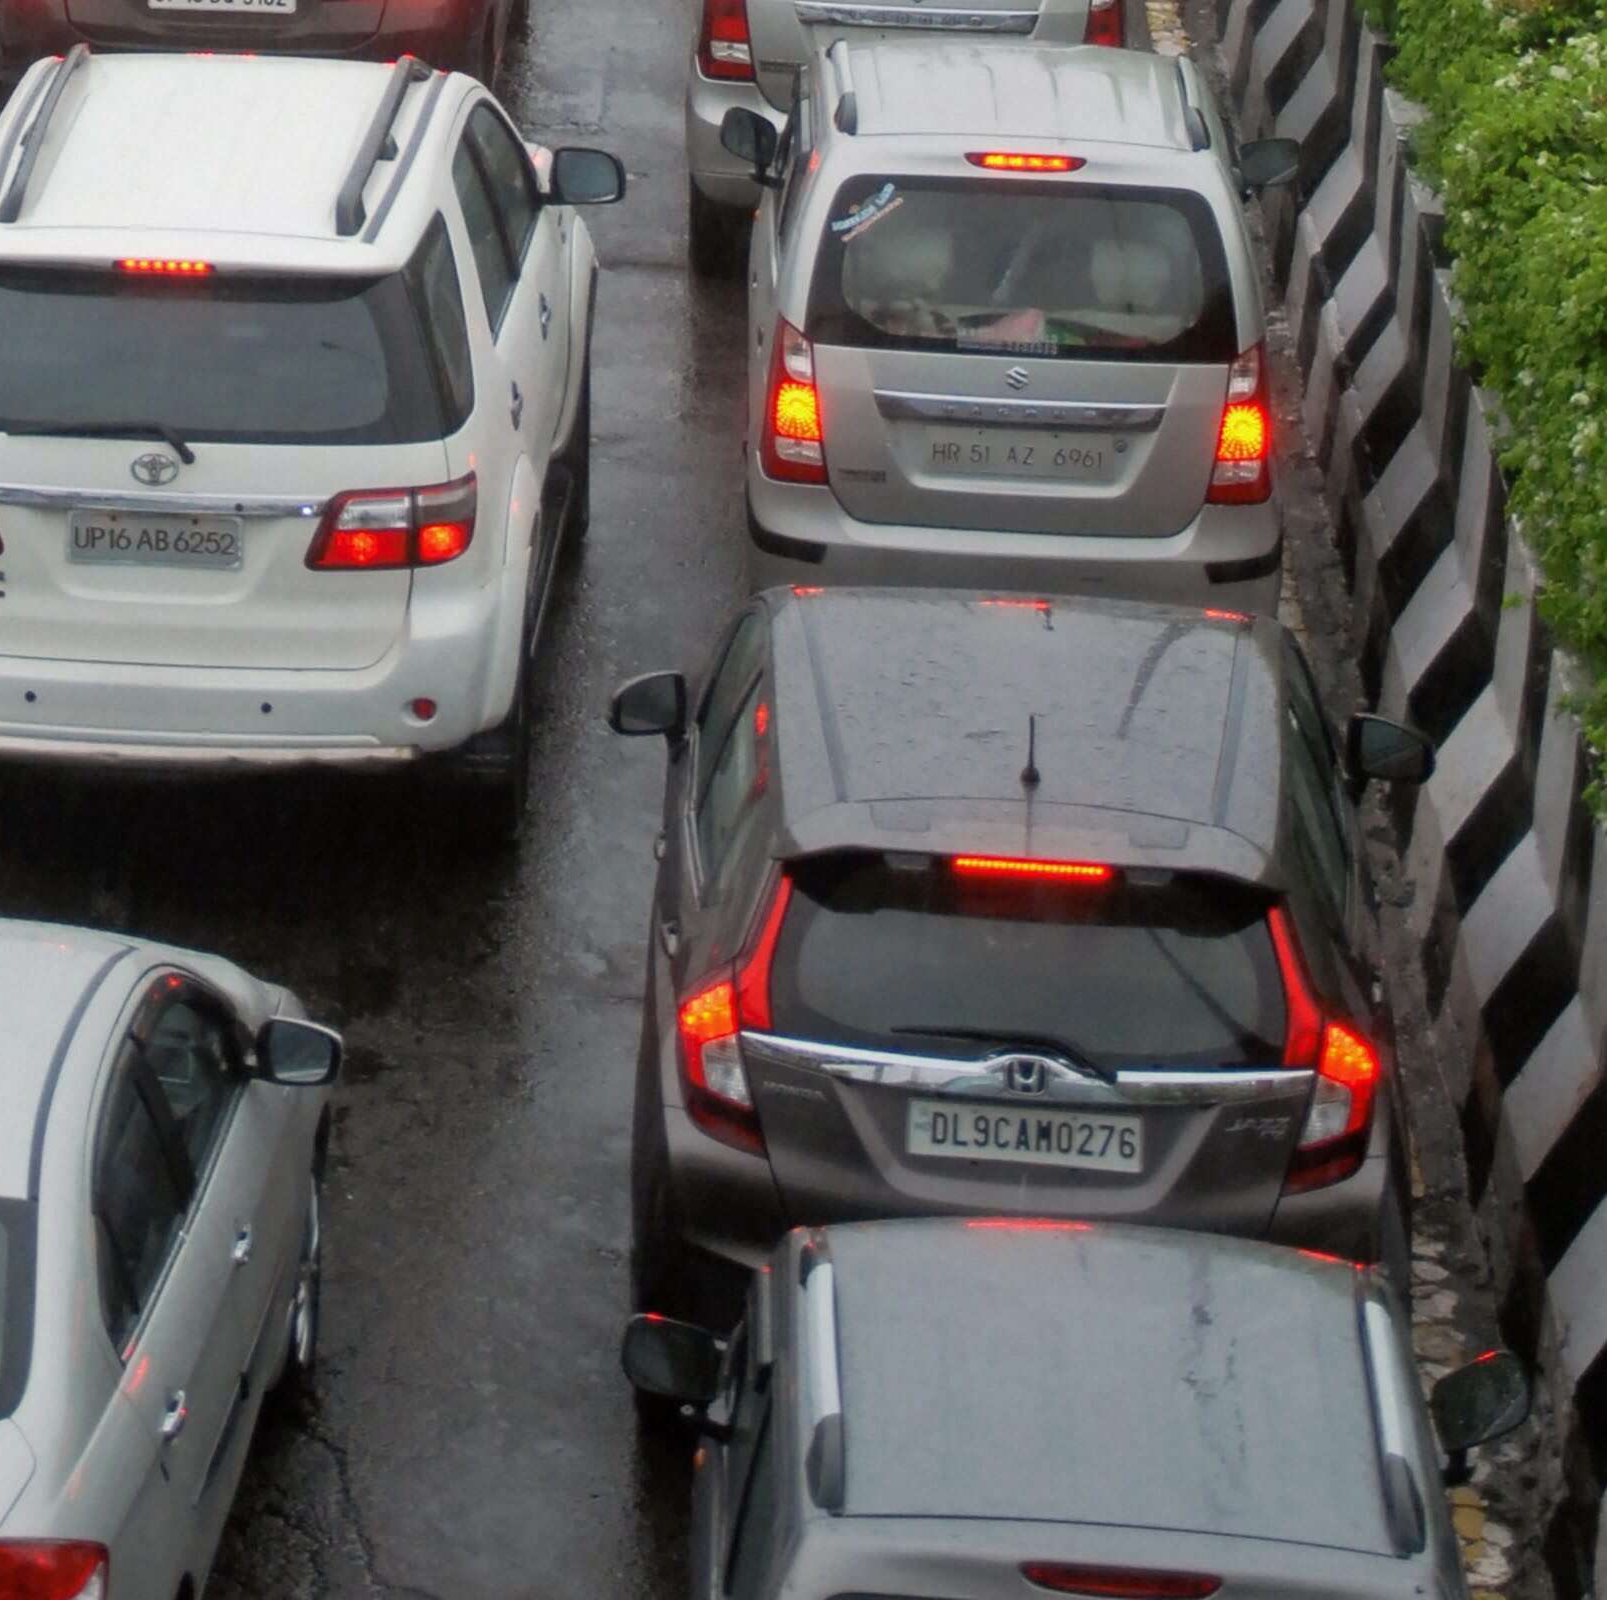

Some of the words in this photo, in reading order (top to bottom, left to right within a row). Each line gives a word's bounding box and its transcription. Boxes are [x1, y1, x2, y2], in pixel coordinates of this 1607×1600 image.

[932, 442, 960, 464] HR
[969, 444, 989, 464] 51
[1005, 446, 1035, 465] AZ
[1053, 448, 1103, 469] 6961
[136, 528, 170, 552] AB
[173, 530, 236, 557] 6252
[930, 1110, 1137, 1160] DL9CAM0276
